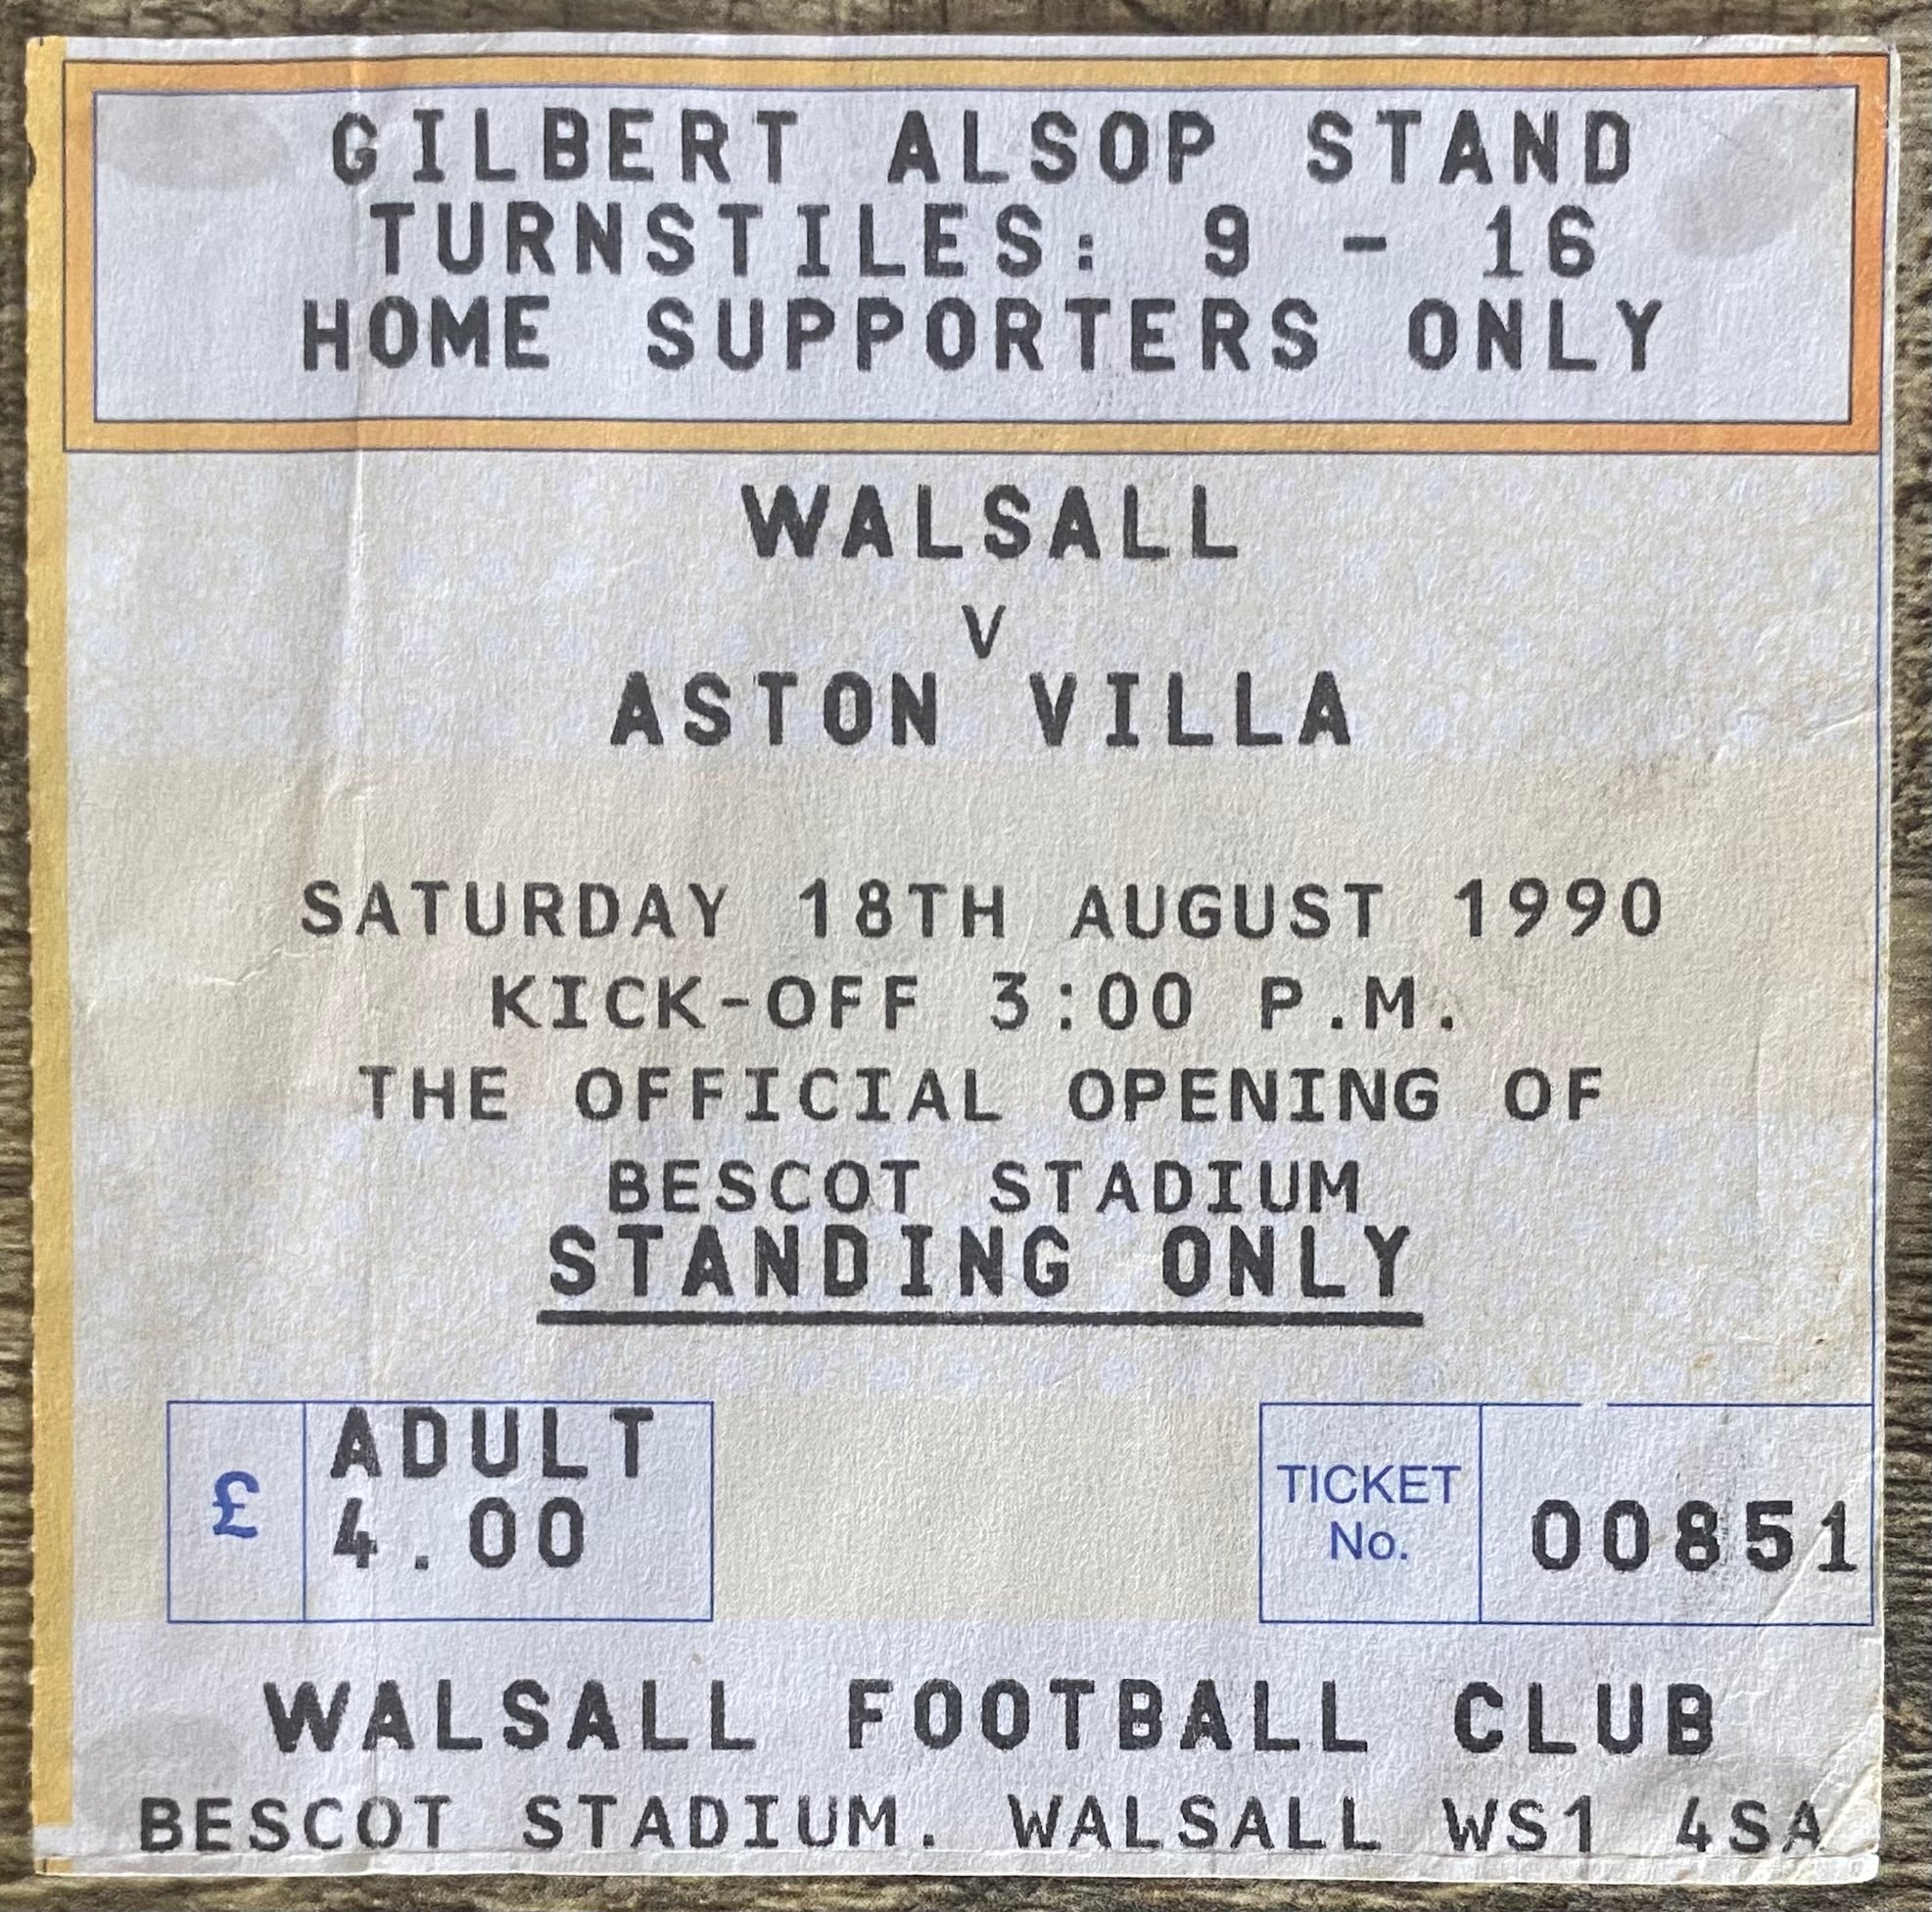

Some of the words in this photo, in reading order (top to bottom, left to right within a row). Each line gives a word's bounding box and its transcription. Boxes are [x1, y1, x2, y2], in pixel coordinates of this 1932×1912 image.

[332, 107, 798, 187] GILBERT
[886, 109, 1215, 185] ALSOP
[1306, 109, 1631, 186] STAND
[369, 200, 1094, 279] TURNSTILES:
[1203, 204, 1249, 279] 9
[1343, 236, 1388, 254] -
[1483, 204, 1596, 280] 16
[303, 294, 550, 372] HOME
[646, 296, 1318, 373] SUPPORTERS
[1407, 298, 1663, 372] ONLY
[740, 483, 1239, 563] WALSALL
[609, 670, 937, 748] ASTON
[1029, 670, 1351, 749] VILLA
[301, 879, 728, 941] SATURDAY
[798, 877, 1005, 940] 18TH
[1069, 881, 1384, 942] AUGUST
[1453, 876, 1662, 939] 1990
[492, 974, 919, 1031] KICK-OFF
[990, 970, 1193, 1033] 3:00
[1260, 974, 1454, 1032] P.M.
[357, 1064, 508, 1122] THE
[575, 1066, 1004, 1124] OFFICIAL
[1067, 1066, 1439, 1124] OPENING
[1504, 1066, 1602, 1122] OF
[608, 1158, 920, 1215] BESCOT
[989, 1159, 1360, 1217] STADIUM
[548, 1223, 1069, 1300] STANDING
[1161, 1224, 1411, 1300] ONLY
[329, 1404, 655, 1481] ADULT
[212, 1470, 260, 1540] £
[1276, 1464, 1462, 1505] TICKET
[332, 1496, 585, 1571] 4.00
[1330, 1520, 1408, 1561] No.
[1531, 1499, 1858, 1575] 00851
[262, 1678, 757, 1755] WALSALL
[848, 1677, 1369, 1755] FOOTBALL
[1453, 1681, 1714, 1758] CLUB
[139, 1795, 452, 1853] BESCOT
[522, 1794, 935, 1852] STADIUM.
[1007, 1794, 1383, 1853] WALSALL
[1440, 1795, 1593, 1855] WS1
[1675, 1795, 1822, 1855] 4SA
